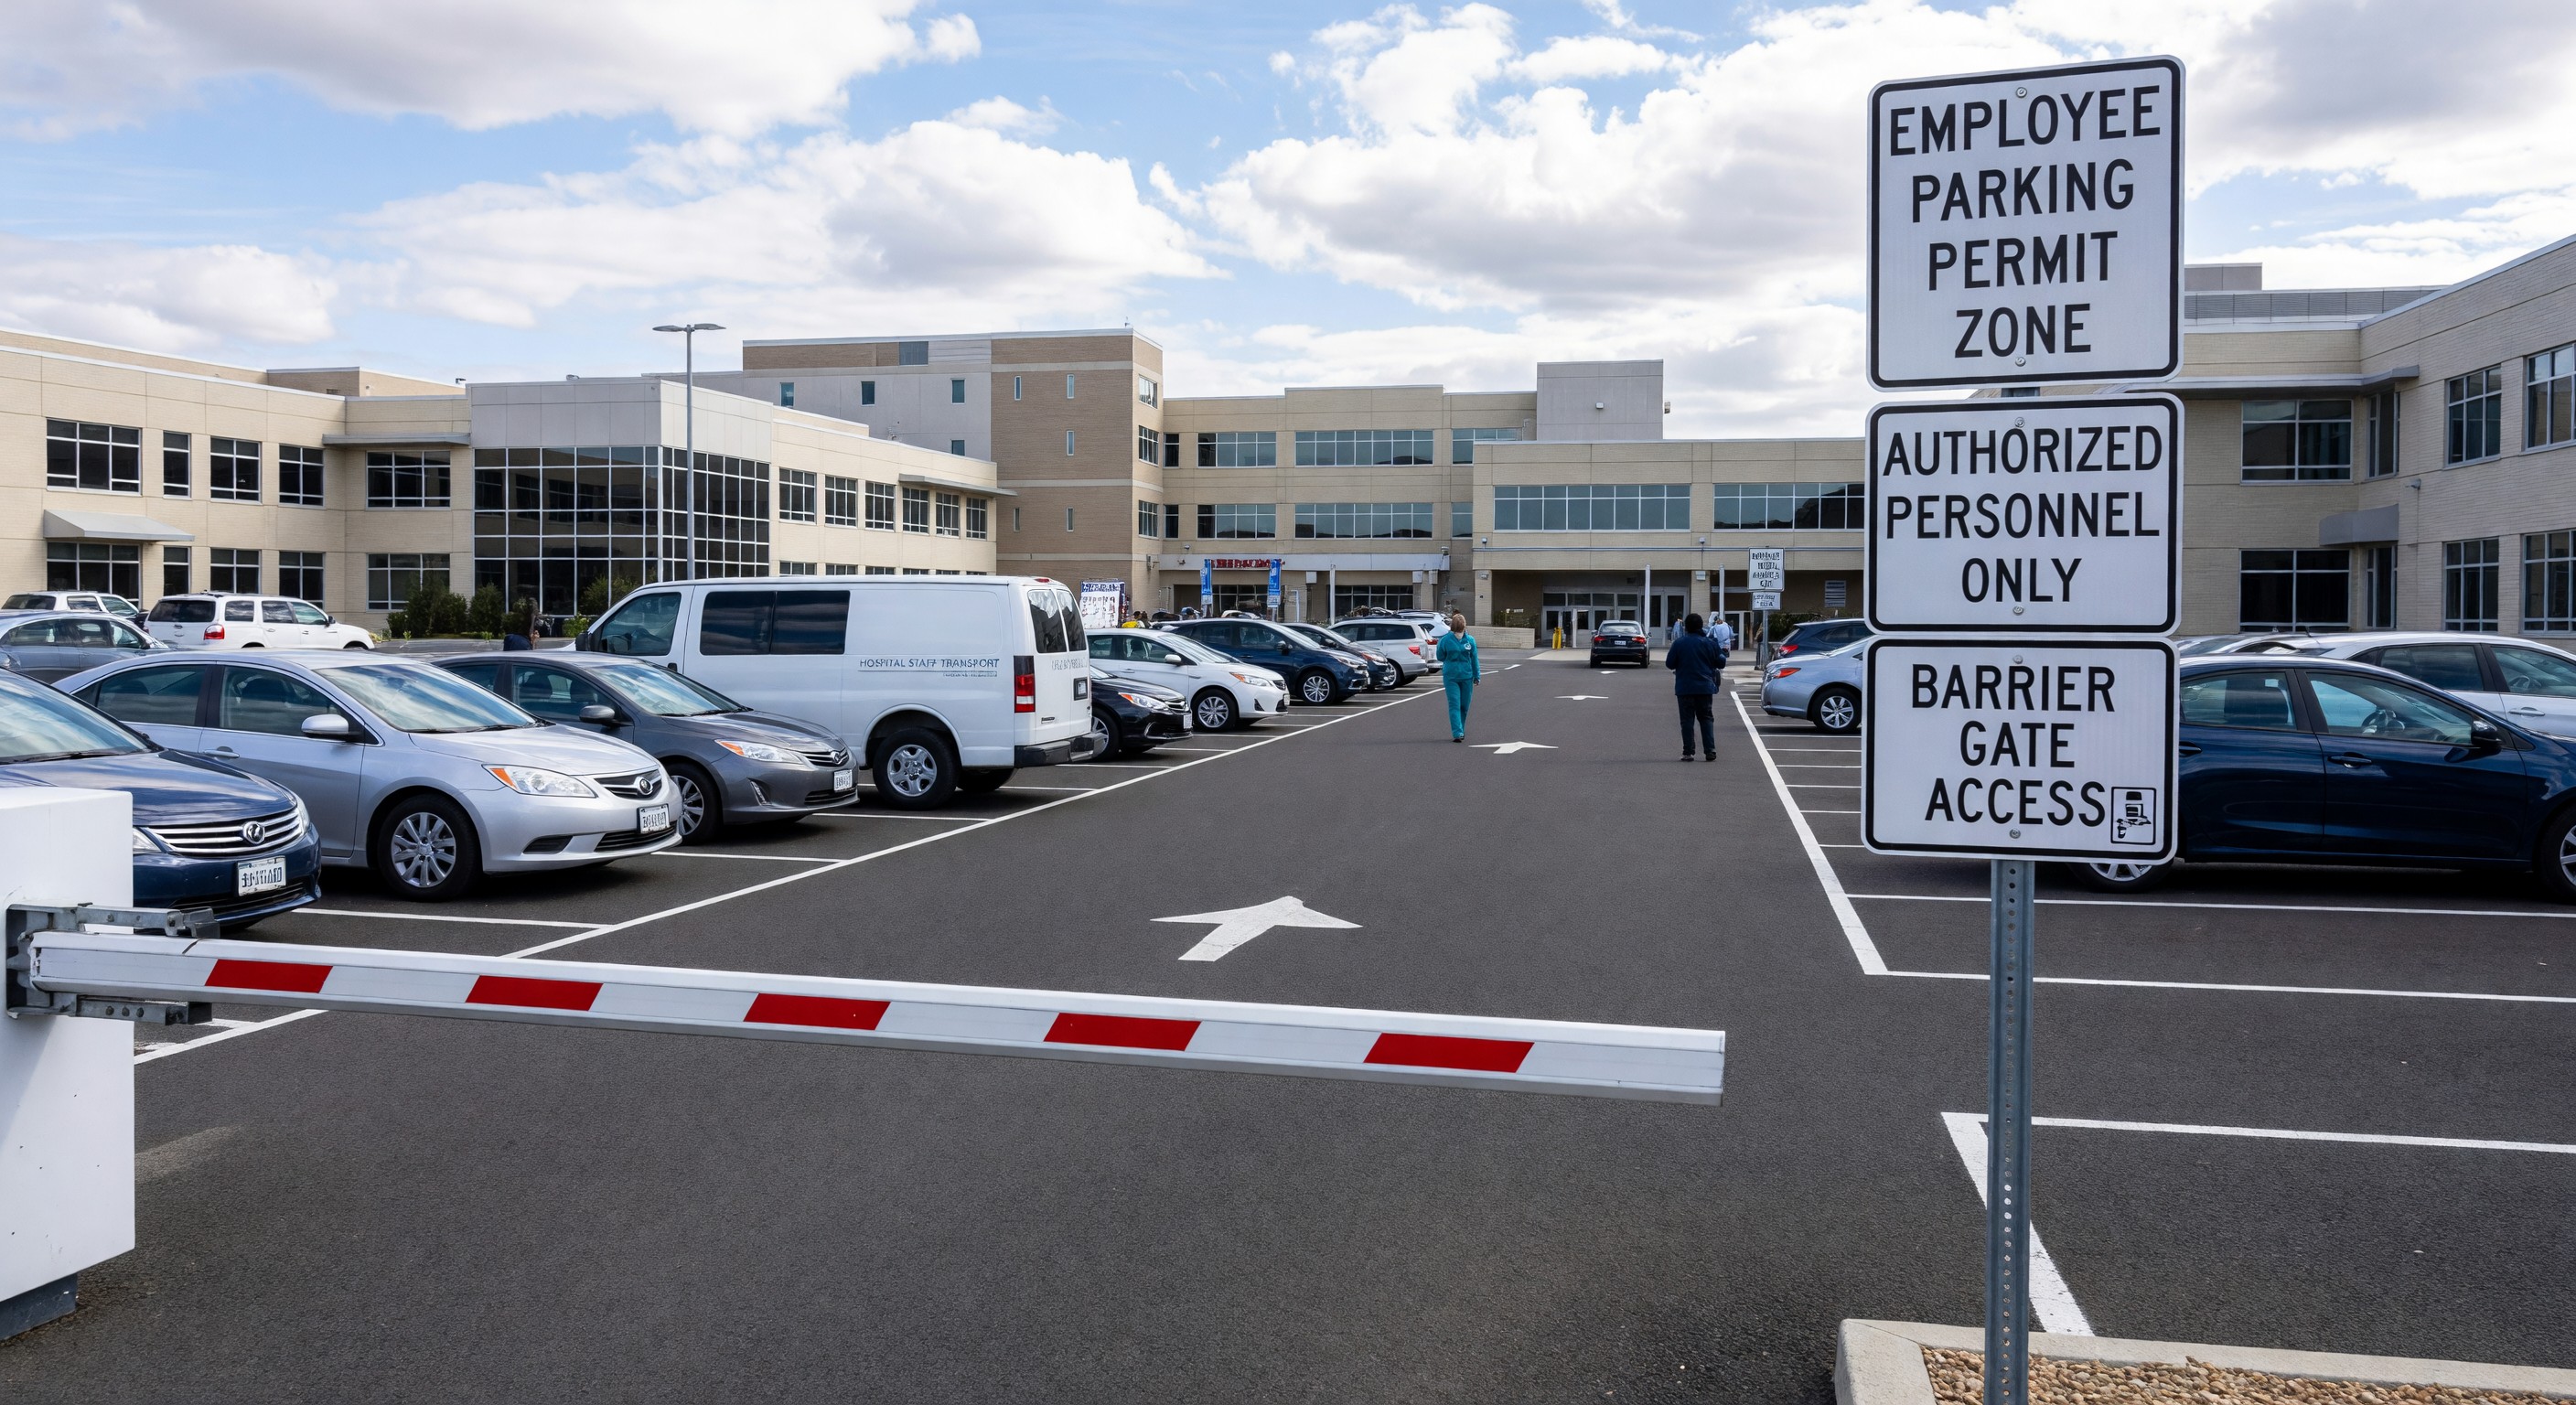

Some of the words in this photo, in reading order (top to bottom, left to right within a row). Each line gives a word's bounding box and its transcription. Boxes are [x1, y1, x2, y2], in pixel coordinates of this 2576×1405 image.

[1890, 84, 2161, 156] EMPLOYEE
[1912, 158, 2134, 223] PARKING
[1928, 231, 2119, 291] PERMIT
[1954, 303, 2091, 359] ZONE
[1883, 425, 2163, 477] AUTHORIZED
[1886, 491, 2160, 540] PERSONNEL
[1961, 557, 2082, 603] ONLY
[860, 659, 906, 668] HOSPITAL
[1912, 663, 2115, 713] BARRIER
[1959, 720, 2075, 768] GATE
[1924, 777, 2106, 828] ACCESS
